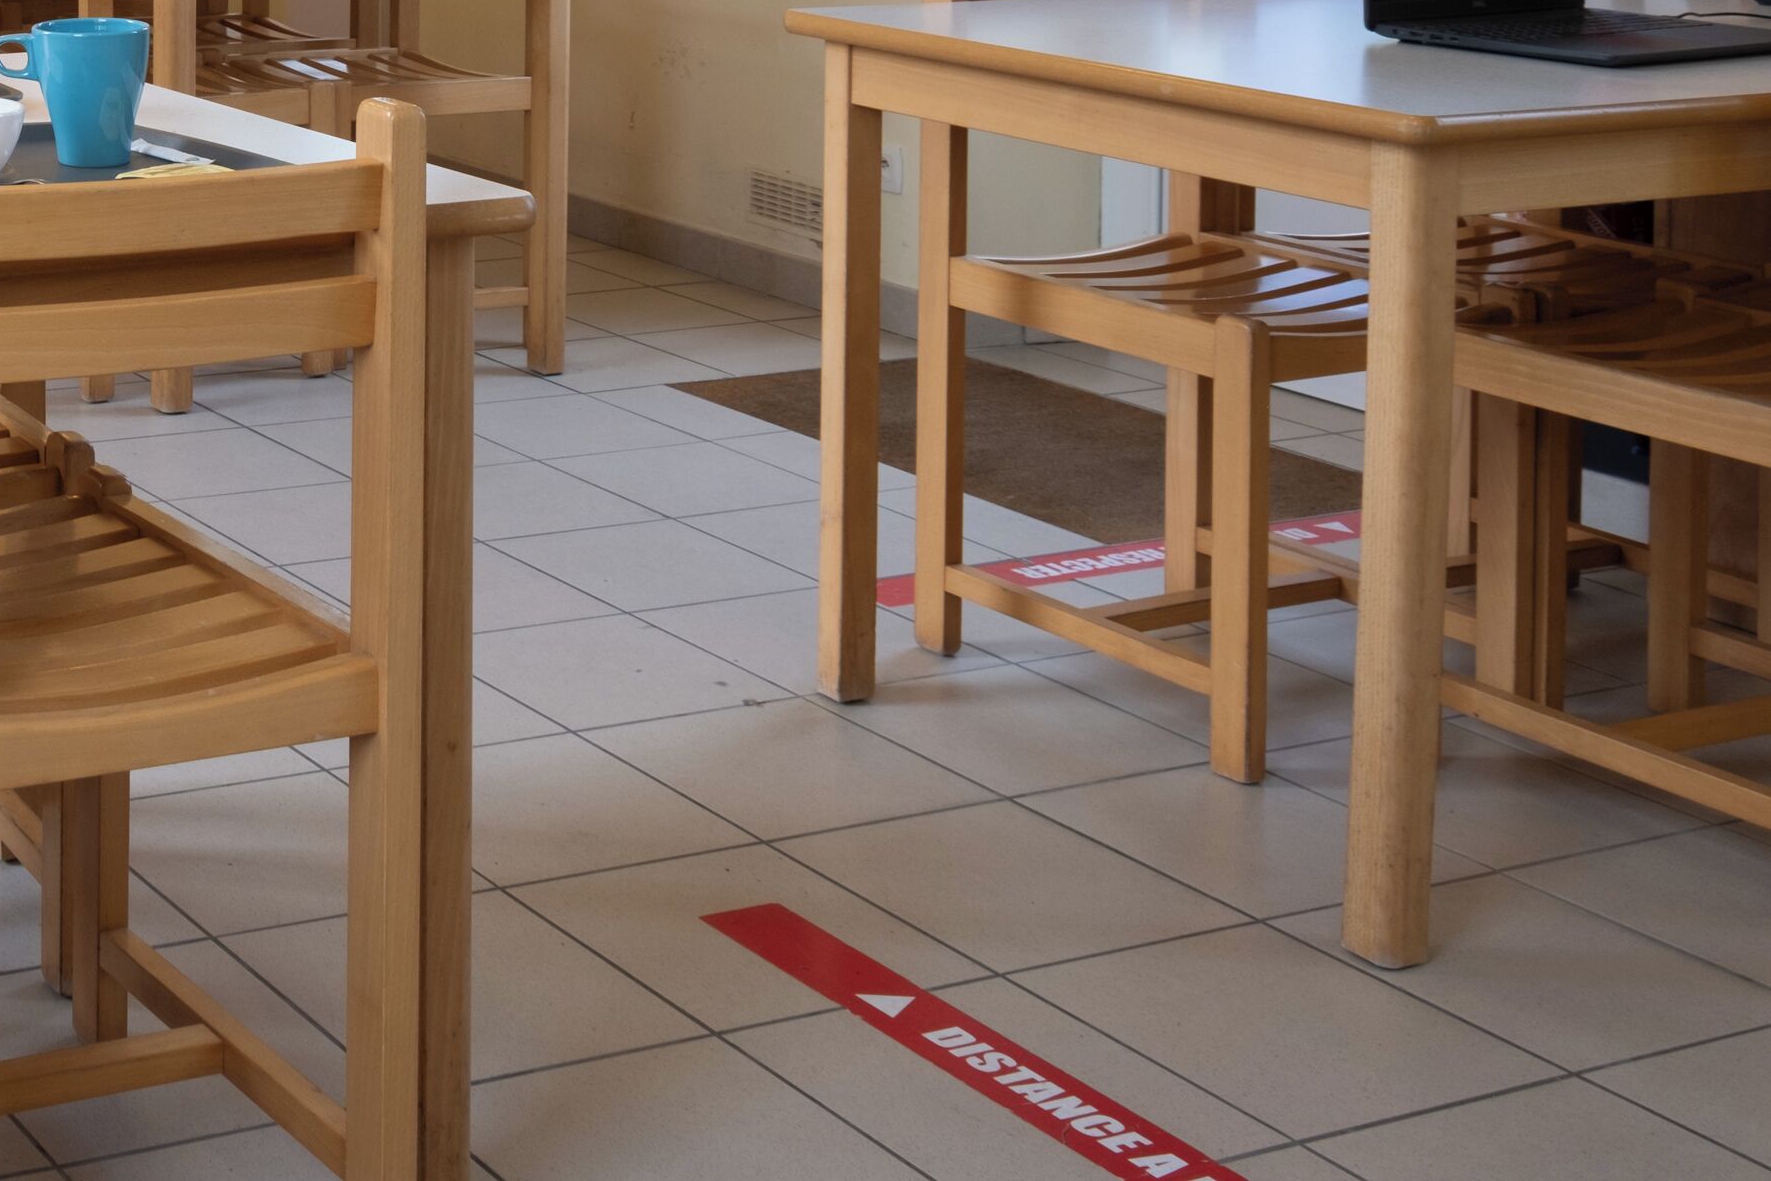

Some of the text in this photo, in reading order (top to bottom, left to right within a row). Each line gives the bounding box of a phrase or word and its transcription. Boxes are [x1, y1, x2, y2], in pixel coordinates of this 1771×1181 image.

[1012, 548, 1164, 581] RESPECTER
[922, 1026, 1189, 1179] DISTANCE A
